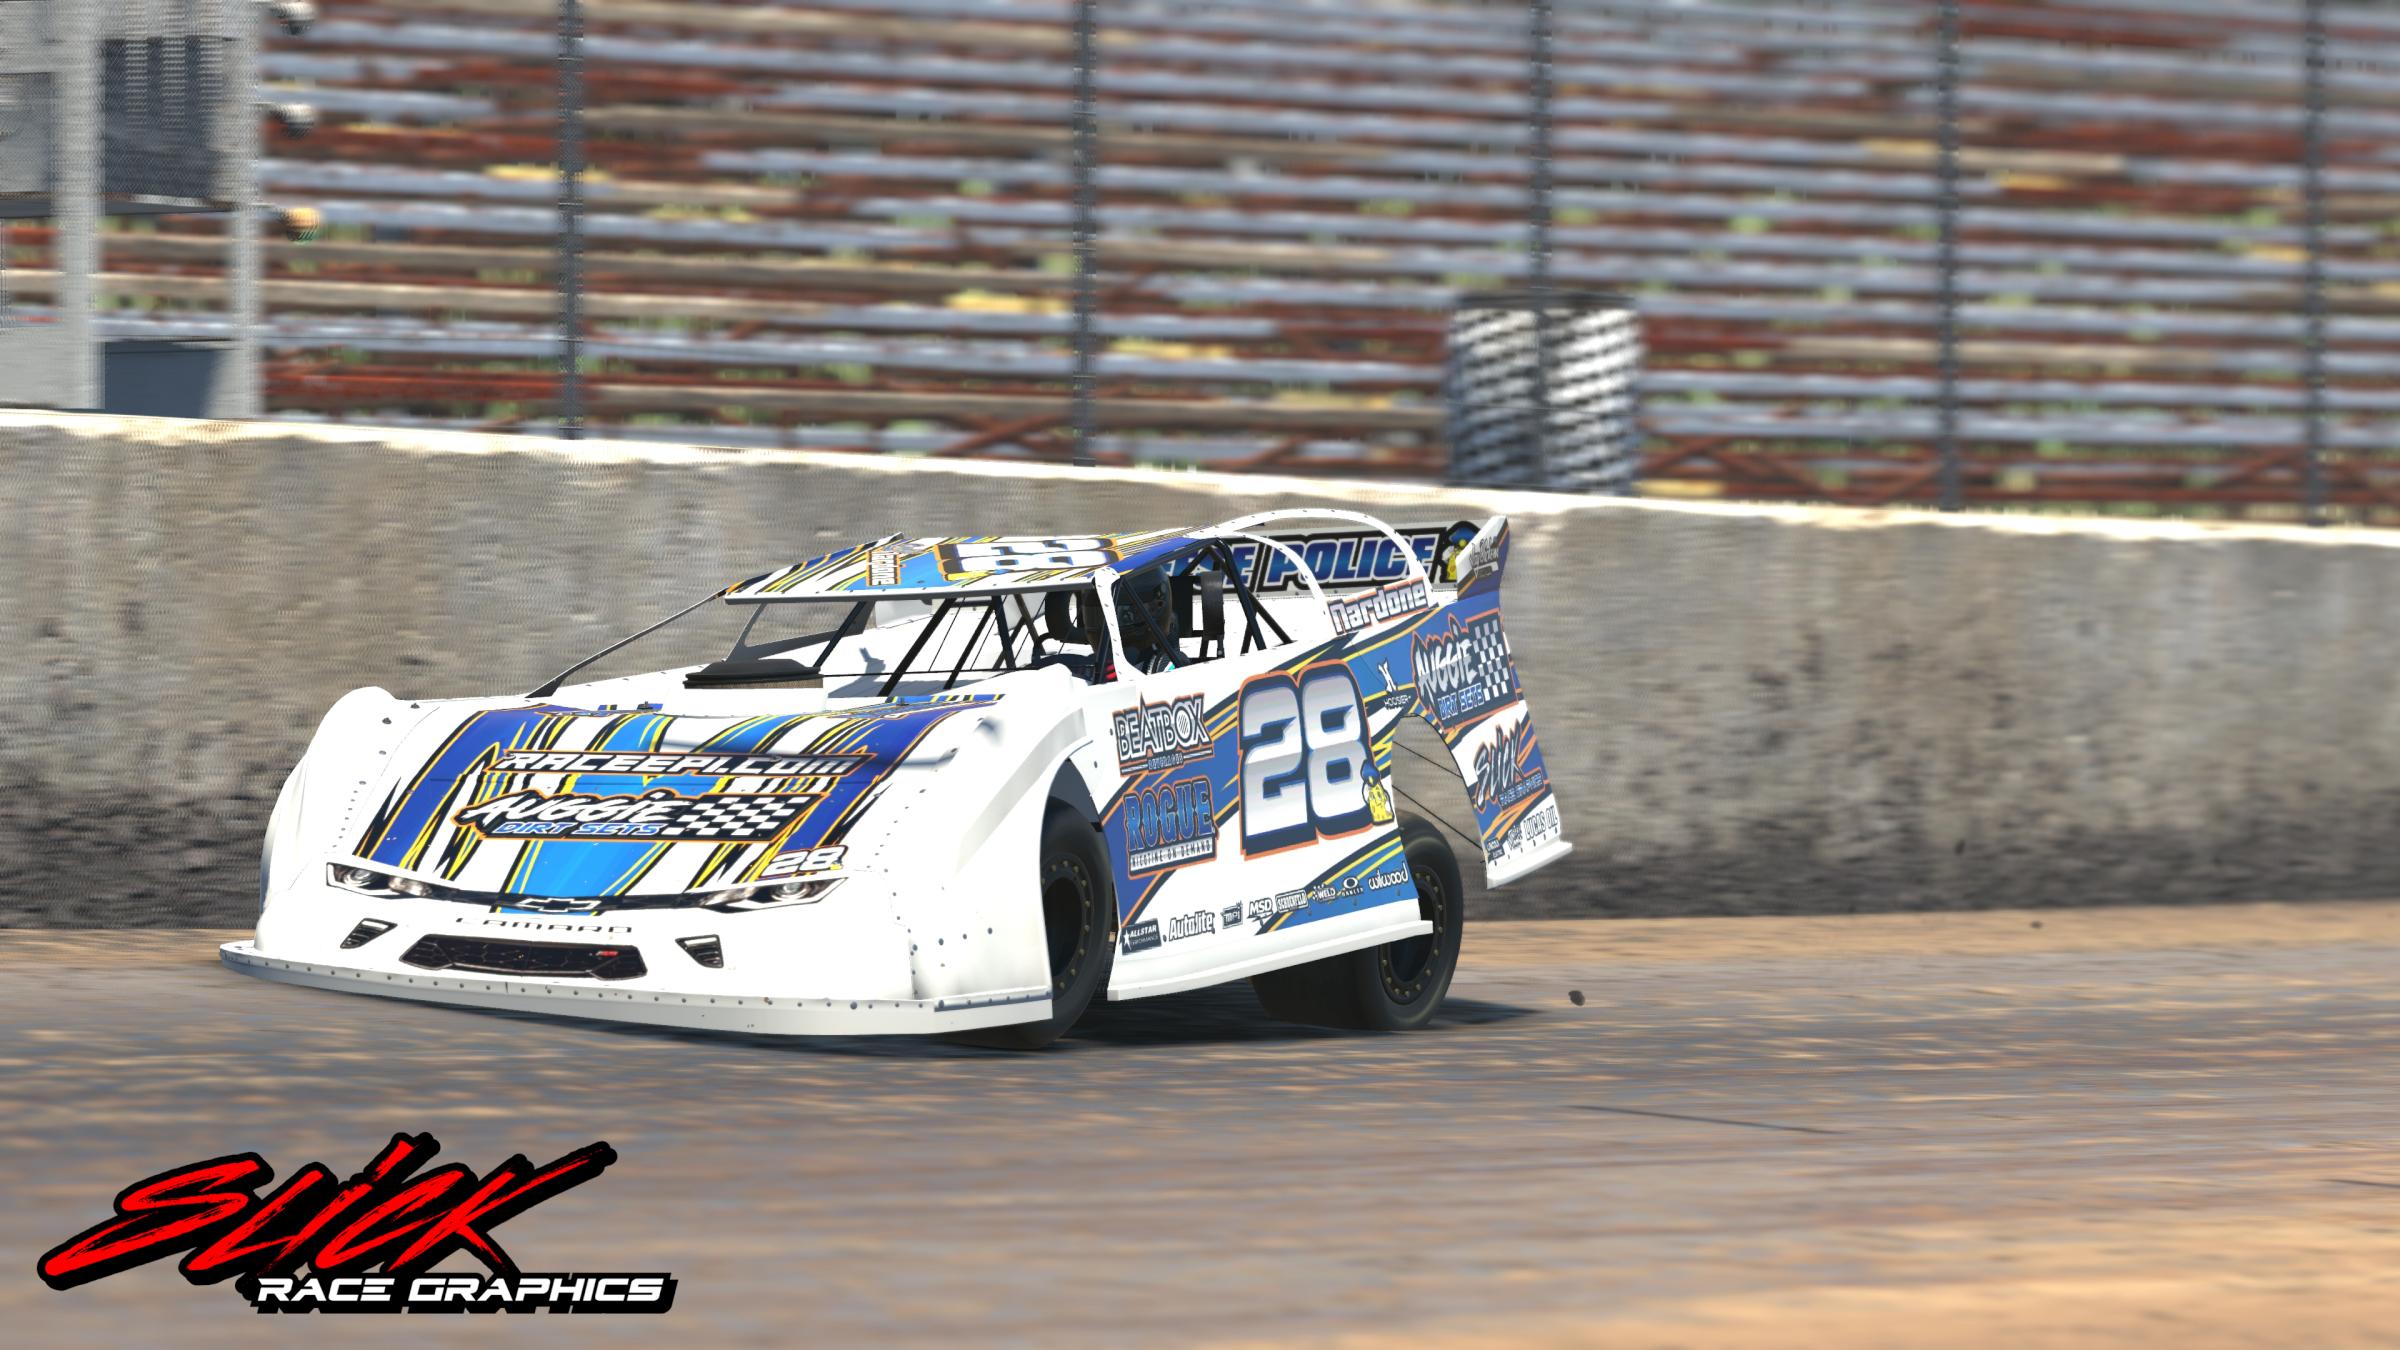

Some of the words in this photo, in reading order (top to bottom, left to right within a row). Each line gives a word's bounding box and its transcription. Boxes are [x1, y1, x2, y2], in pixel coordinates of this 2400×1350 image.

[1458, 683, 1485, 712] SETS
[1116, 696, 1211, 761] BEATBOX
[1241, 666, 1370, 840] 28
[495, 821, 565, 835] DIRT
[573, 821, 669, 836] SETS
[1125, 780, 1213, 850] ROGUE
[1523, 811, 1546, 841] LUCAS
[1546, 805, 1558, 830] OIL
[763, 846, 847, 876] 28
[1131, 850, 1163, 867] NICOTINE
[1167, 848, 1177, 860] ON
[1181, 839, 1211, 858] DEMAND
[1250, 898, 1273, 916] MSD
[1317, 887, 1336, 899] WELD
[1129, 925, 1157, 938] ALLSTAR
[1169, 911, 1215, 941] Autolite
